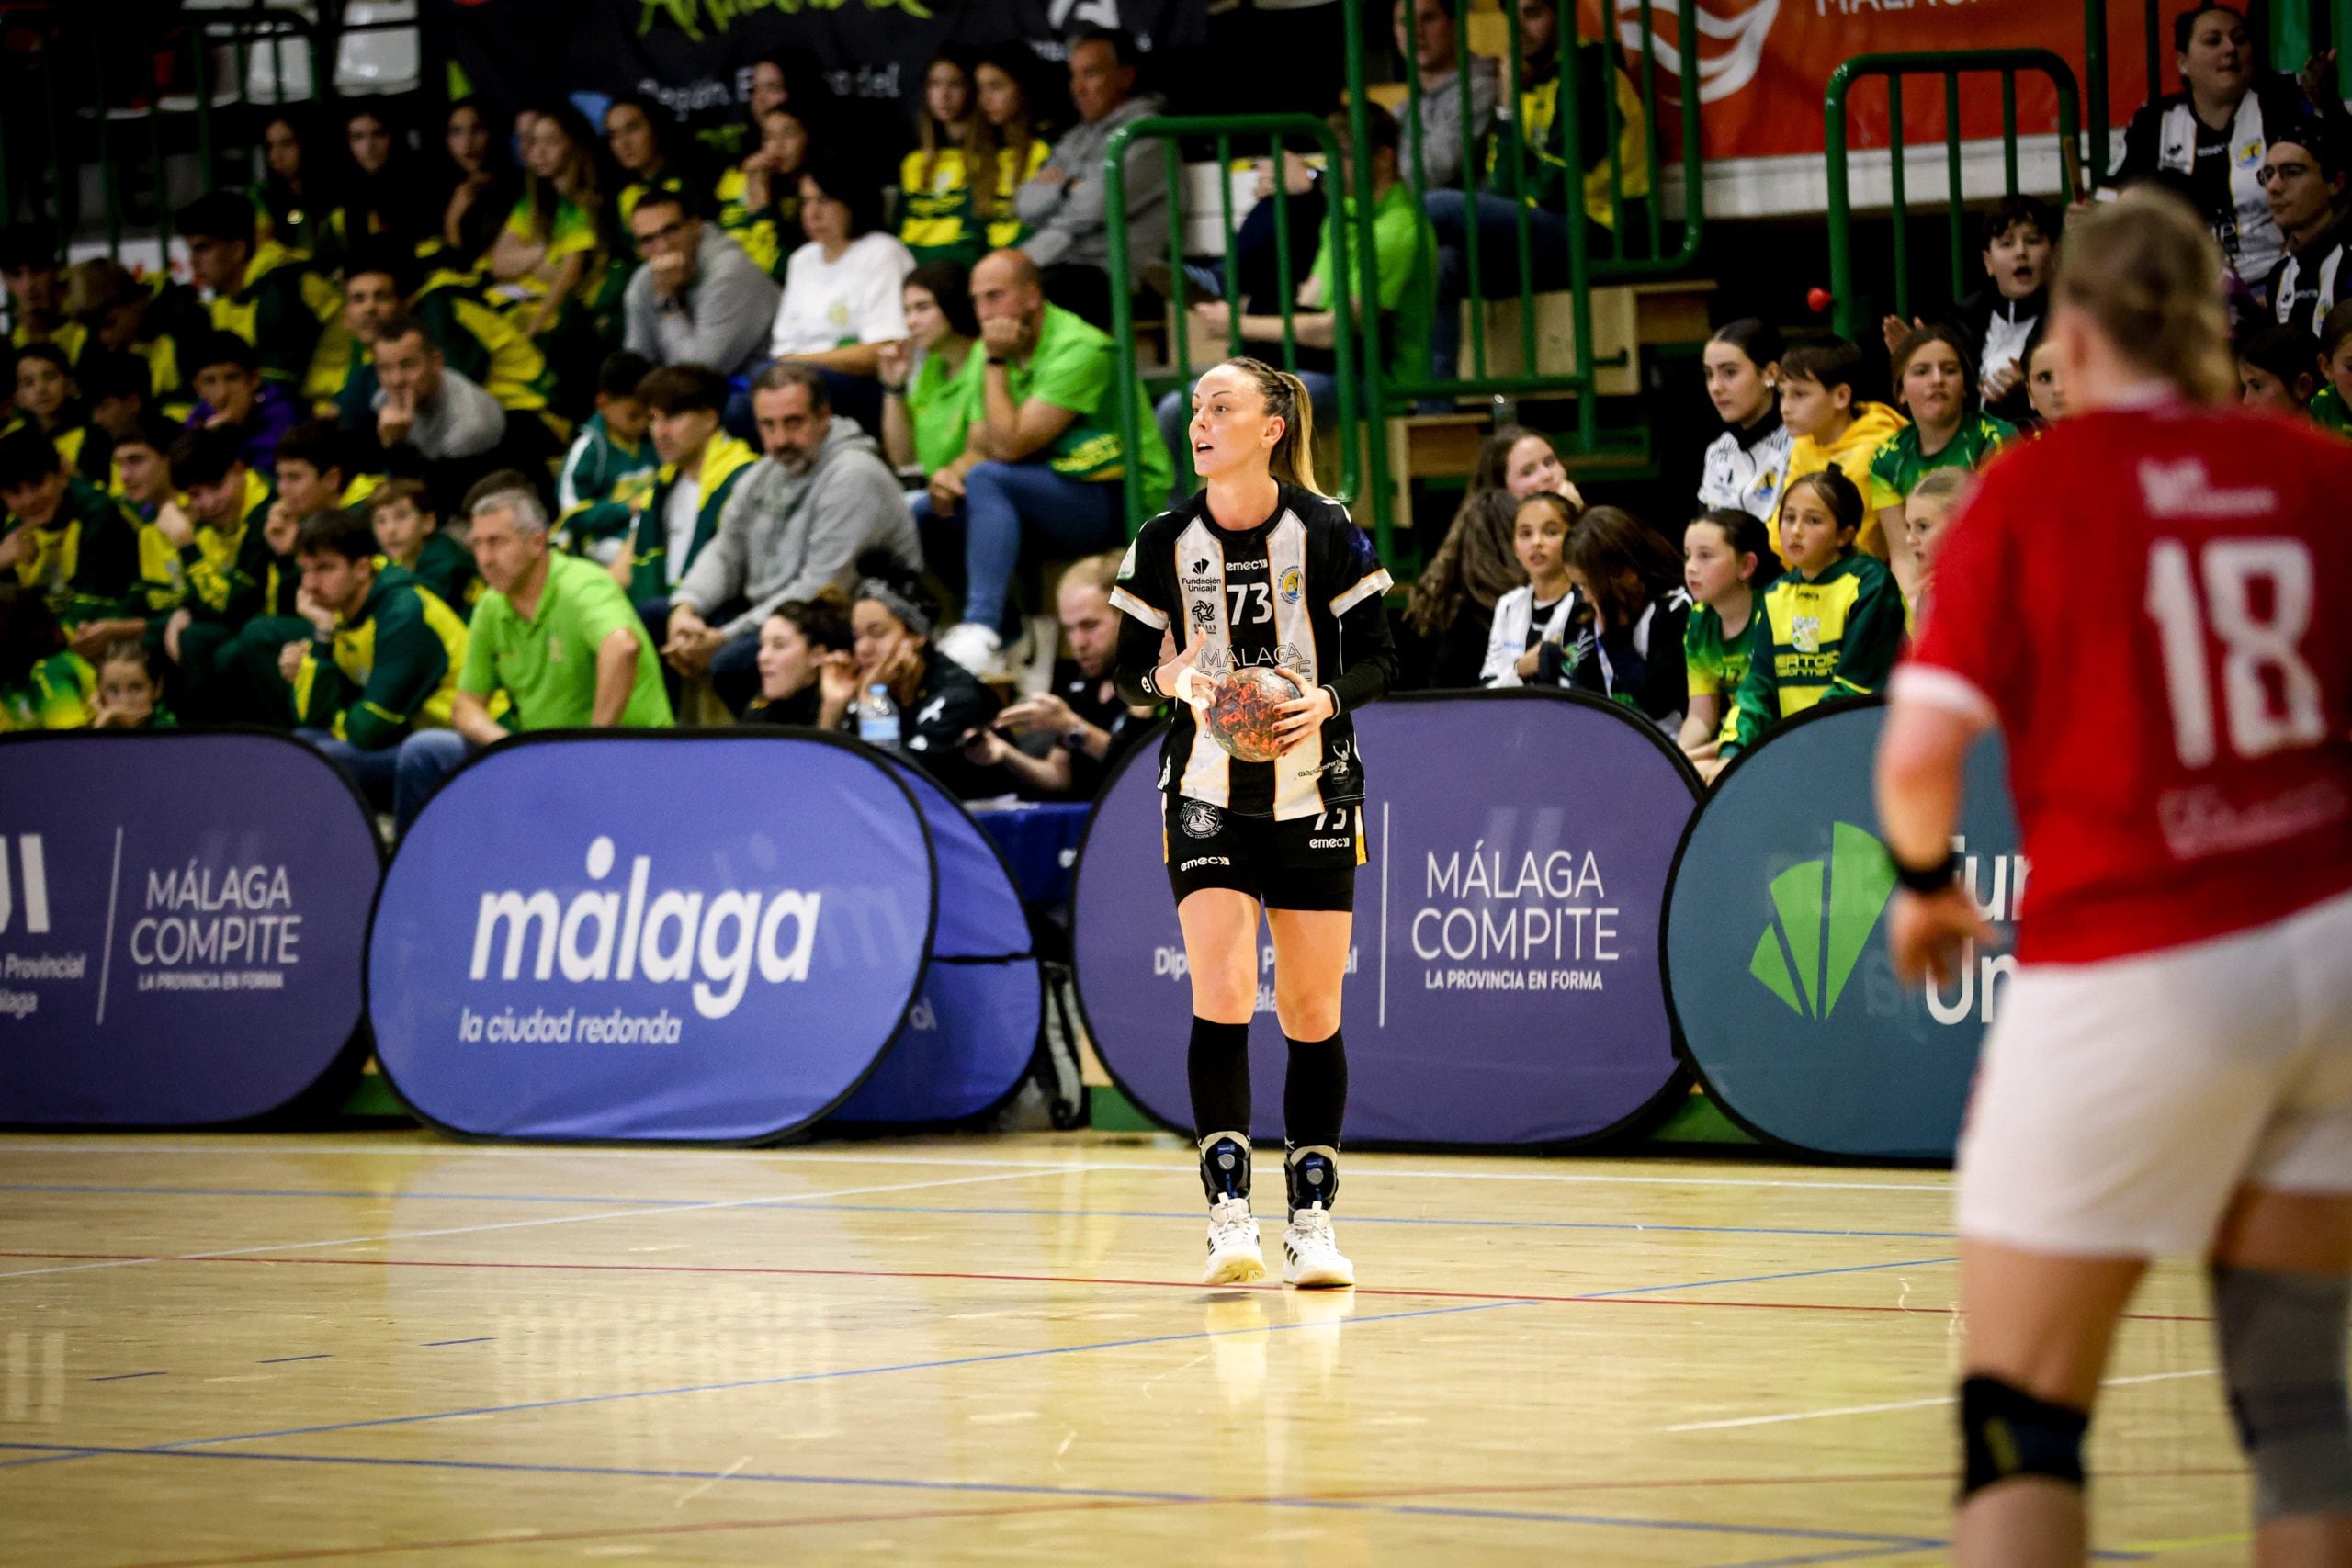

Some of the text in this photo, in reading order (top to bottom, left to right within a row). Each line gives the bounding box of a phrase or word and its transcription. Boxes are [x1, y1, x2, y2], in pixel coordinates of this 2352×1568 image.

[1182, 577, 1221, 585] Fundación
[1188, 585, 1217, 593] Unicaja
[1227, 581, 1273, 626] 73
[2145, 536, 2326, 769] 18
[145, 857, 292, 911] MÁLAGA
[1427, 839, 1604, 898] MÁLAGA
[130, 914, 303, 965] COMPITE
[1411, 908, 1619, 960] COMPITE
[5, 953, 86, 979] Provincial
[140, 971, 284, 991] LA PROVINCIA EN FORMA
[1425, 970, 1603, 990] LA PROVINCIA EN FORMA
[459, 1006, 683, 1044] la ciudad redonda
